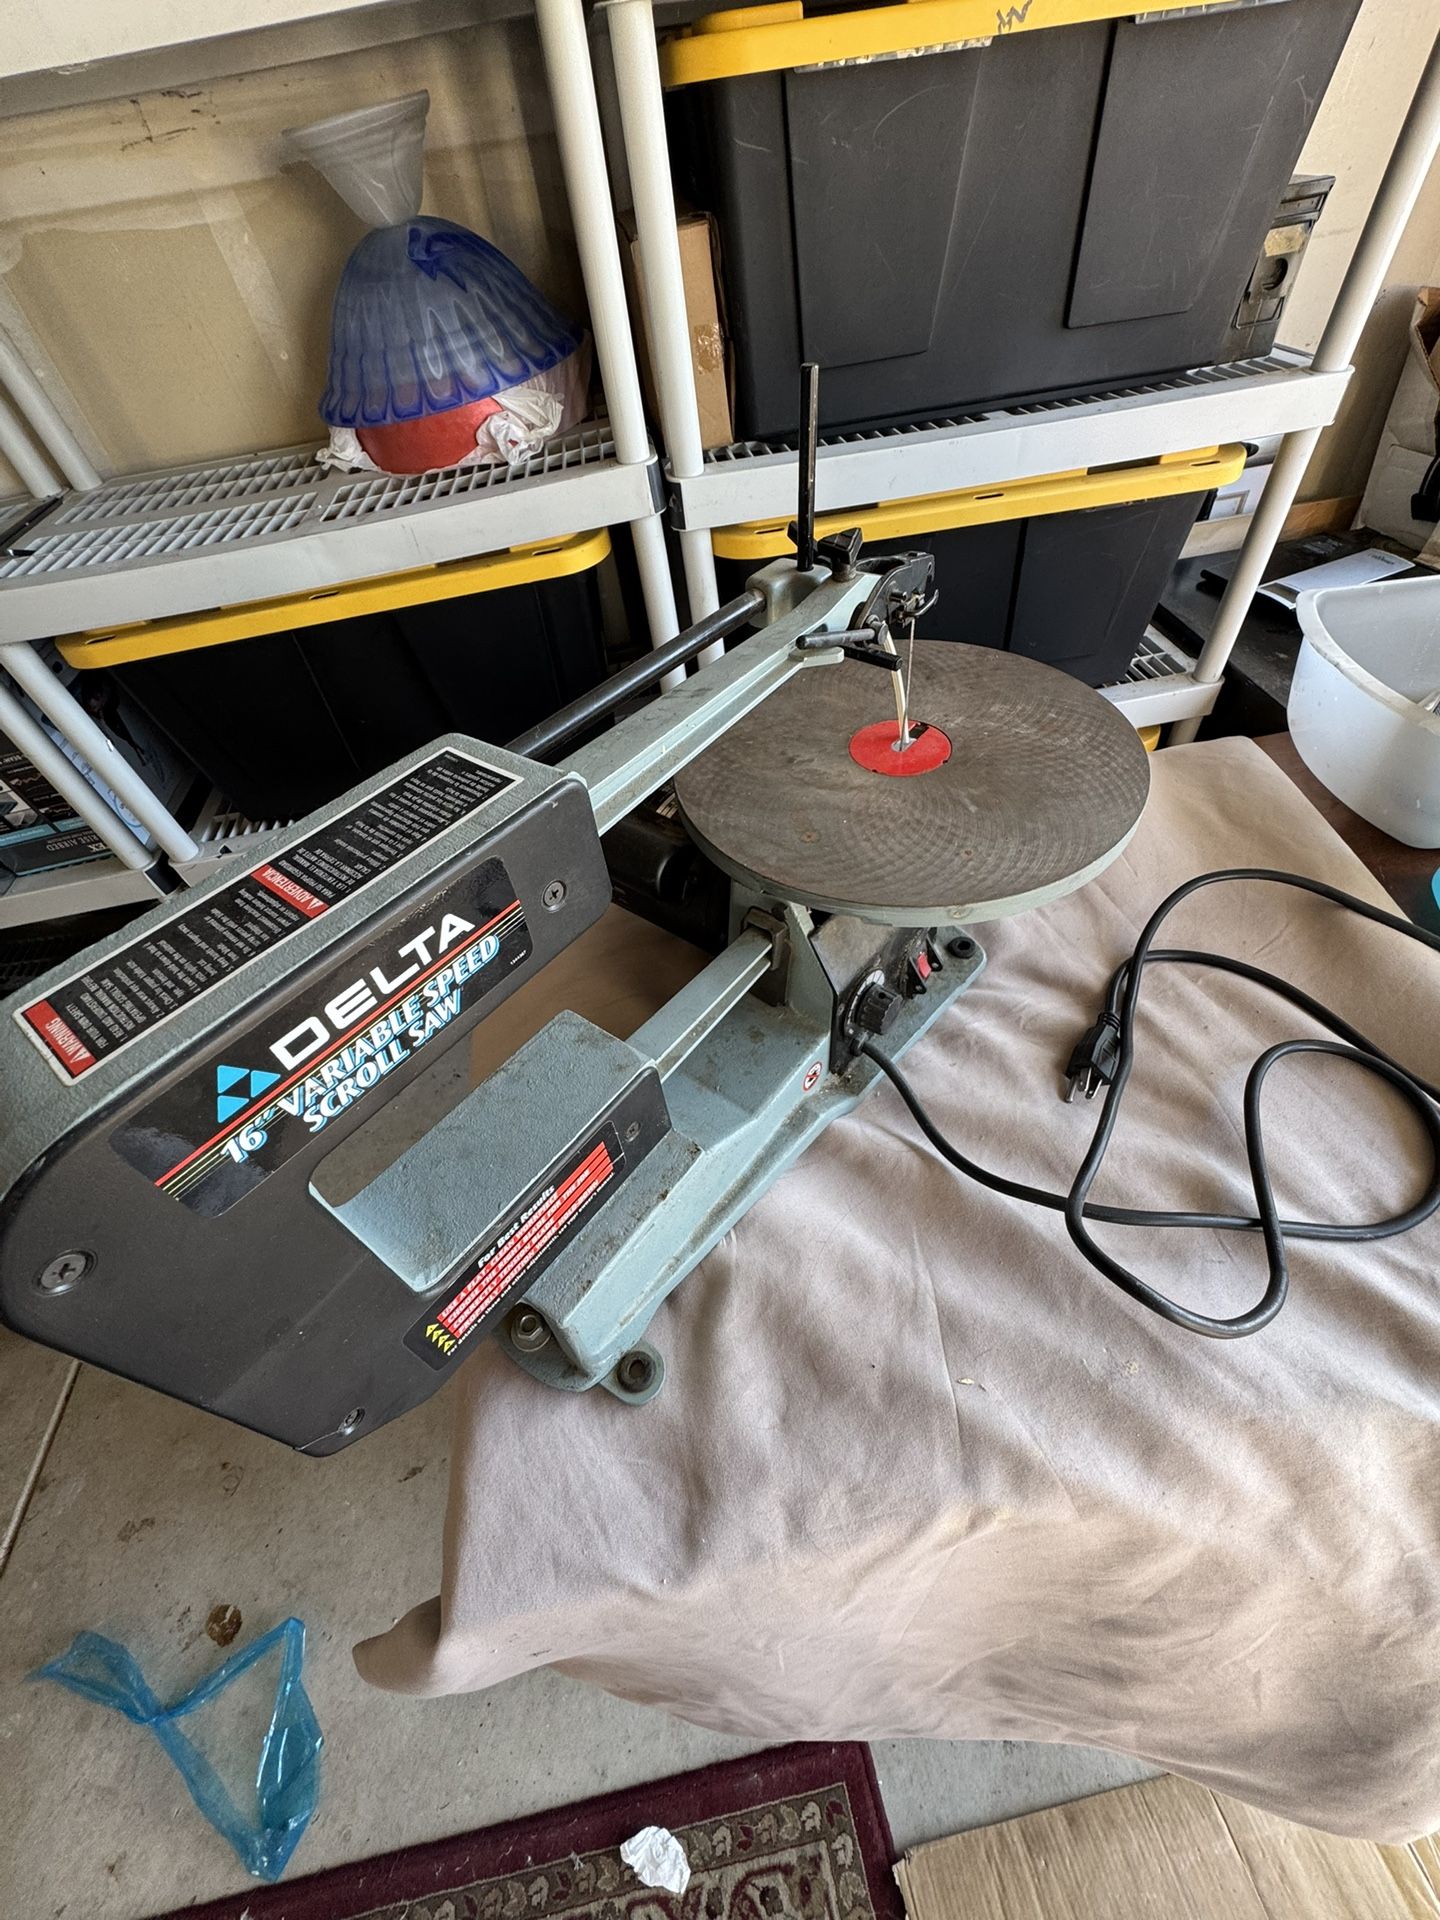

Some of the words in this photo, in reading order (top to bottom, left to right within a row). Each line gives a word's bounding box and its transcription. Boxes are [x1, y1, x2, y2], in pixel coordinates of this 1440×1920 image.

[46, 838, 78, 852] AIRBED
[263, 869, 311, 902] ADVERTENCIA
[81, 976, 99, 991] BEFORE
[95, 989, 112, 1006] MANUAL
[110, 986, 127, 1003] SCROLL
[270, 914, 475, 1071] DELTA
[66, 1004, 83, 1019] SAFETY
[81, 993, 107, 1018] UNDERSTAND
[108, 1004, 134, 1030] INSTRUCTION
[122, 1000, 146, 1022] OPERATING
[46, 1018, 80, 1054] WARNING
[86, 1026, 100, 1039] YOUR
[109, 1024, 124, 1037] READ
[278, 995, 425, 1117] VARIABLE
[422, 935, 500, 1006] SPEED
[303, 1037, 410, 1132] SCROLL
[412, 989, 464, 1048] SAW
[478, 1243, 496, 1269] For
[497, 1219, 519, 1249] Best
[520, 1183, 554, 1224] Results
[442, 1295, 458, 1320] USE
[460, 1286, 467, 1300] A
[490, 1236, 514, 1268] CLEAN
[515, 1191, 557, 1241] WORKPIECE
[447, 1284, 479, 1325] CHOOSE
[481, 1265, 497, 1289] THE
[499, 1239, 522, 1270] RIGHT
[522, 1214, 546, 1244] BLADE
[547, 1198, 561, 1218] FOR
[562, 1182, 576, 1201] THE
[453, 1276, 497, 1330] CORRECTLY
[499, 1241, 530, 1281] TENSION
[531, 1215, 554, 1245] BLADE
[459, 1285, 498, 1336] PROPERLY
[500, 1246, 535, 1290] POSITION
[535, 1222, 558, 1251] WORK
